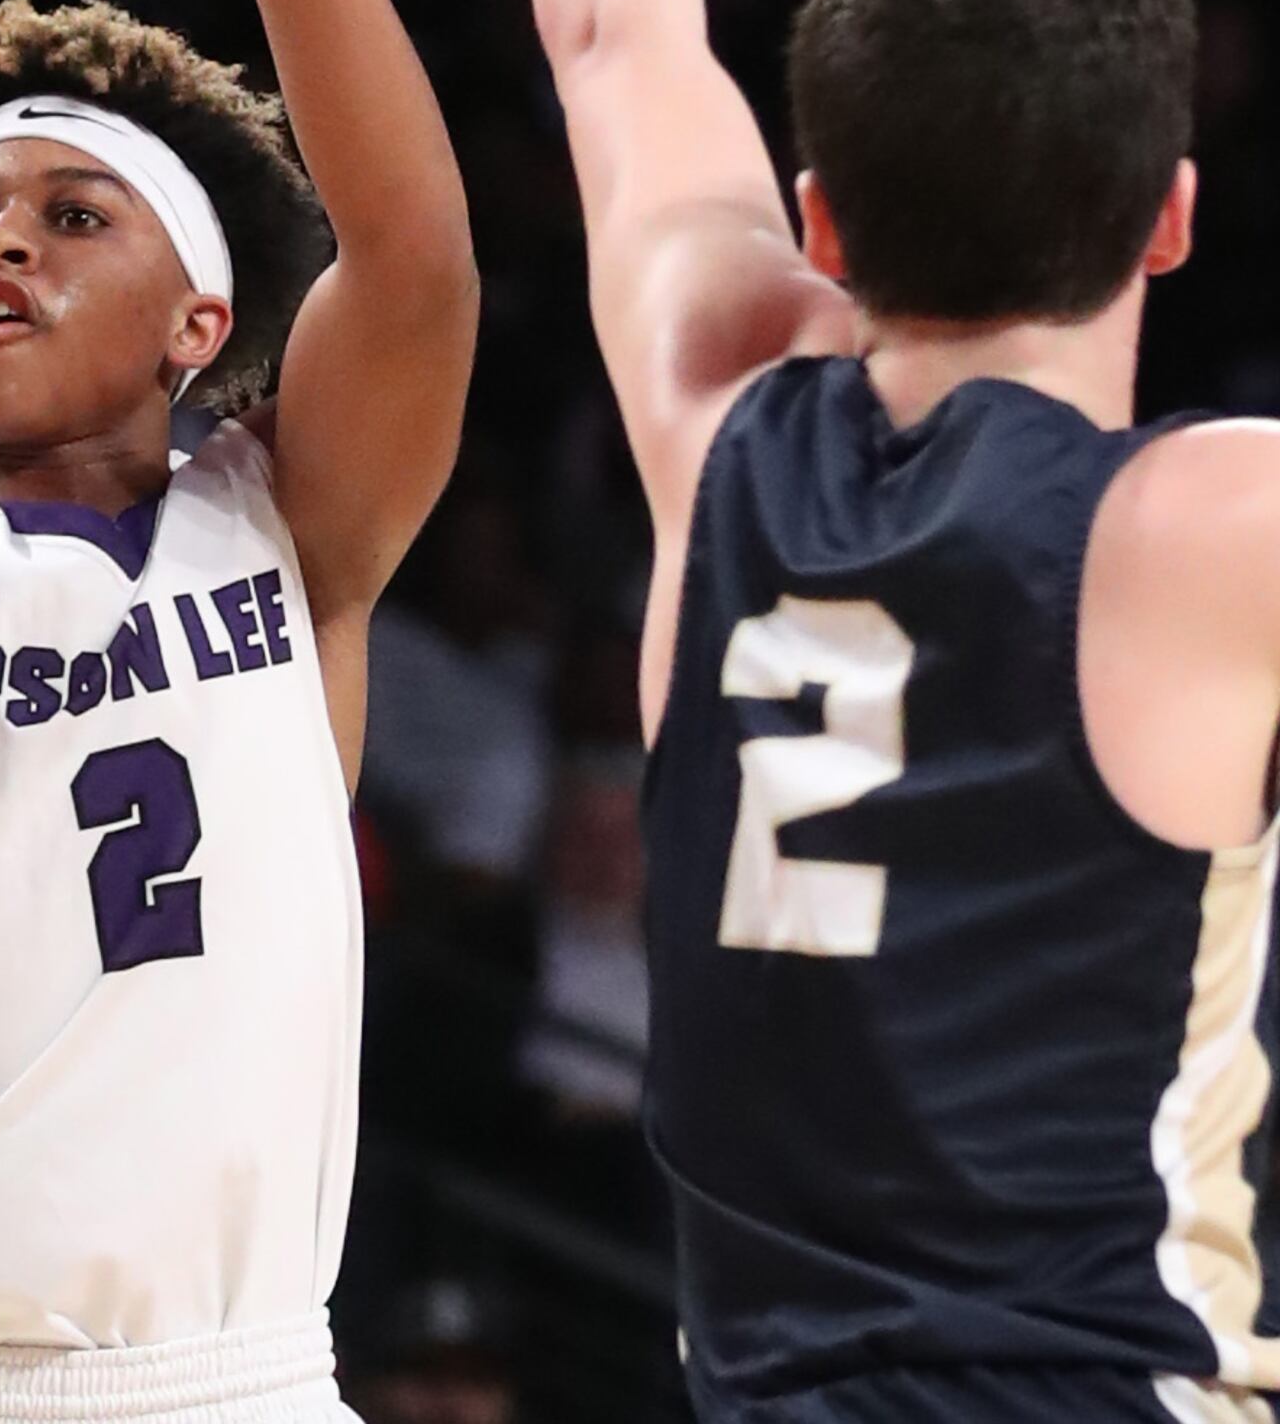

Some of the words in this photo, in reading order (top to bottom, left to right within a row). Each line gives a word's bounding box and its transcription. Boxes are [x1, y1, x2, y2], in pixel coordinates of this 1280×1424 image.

[174, 568, 293, 681] LEE
[70, 737, 205, 974] 2
[717, 593, 916, 957] 2
